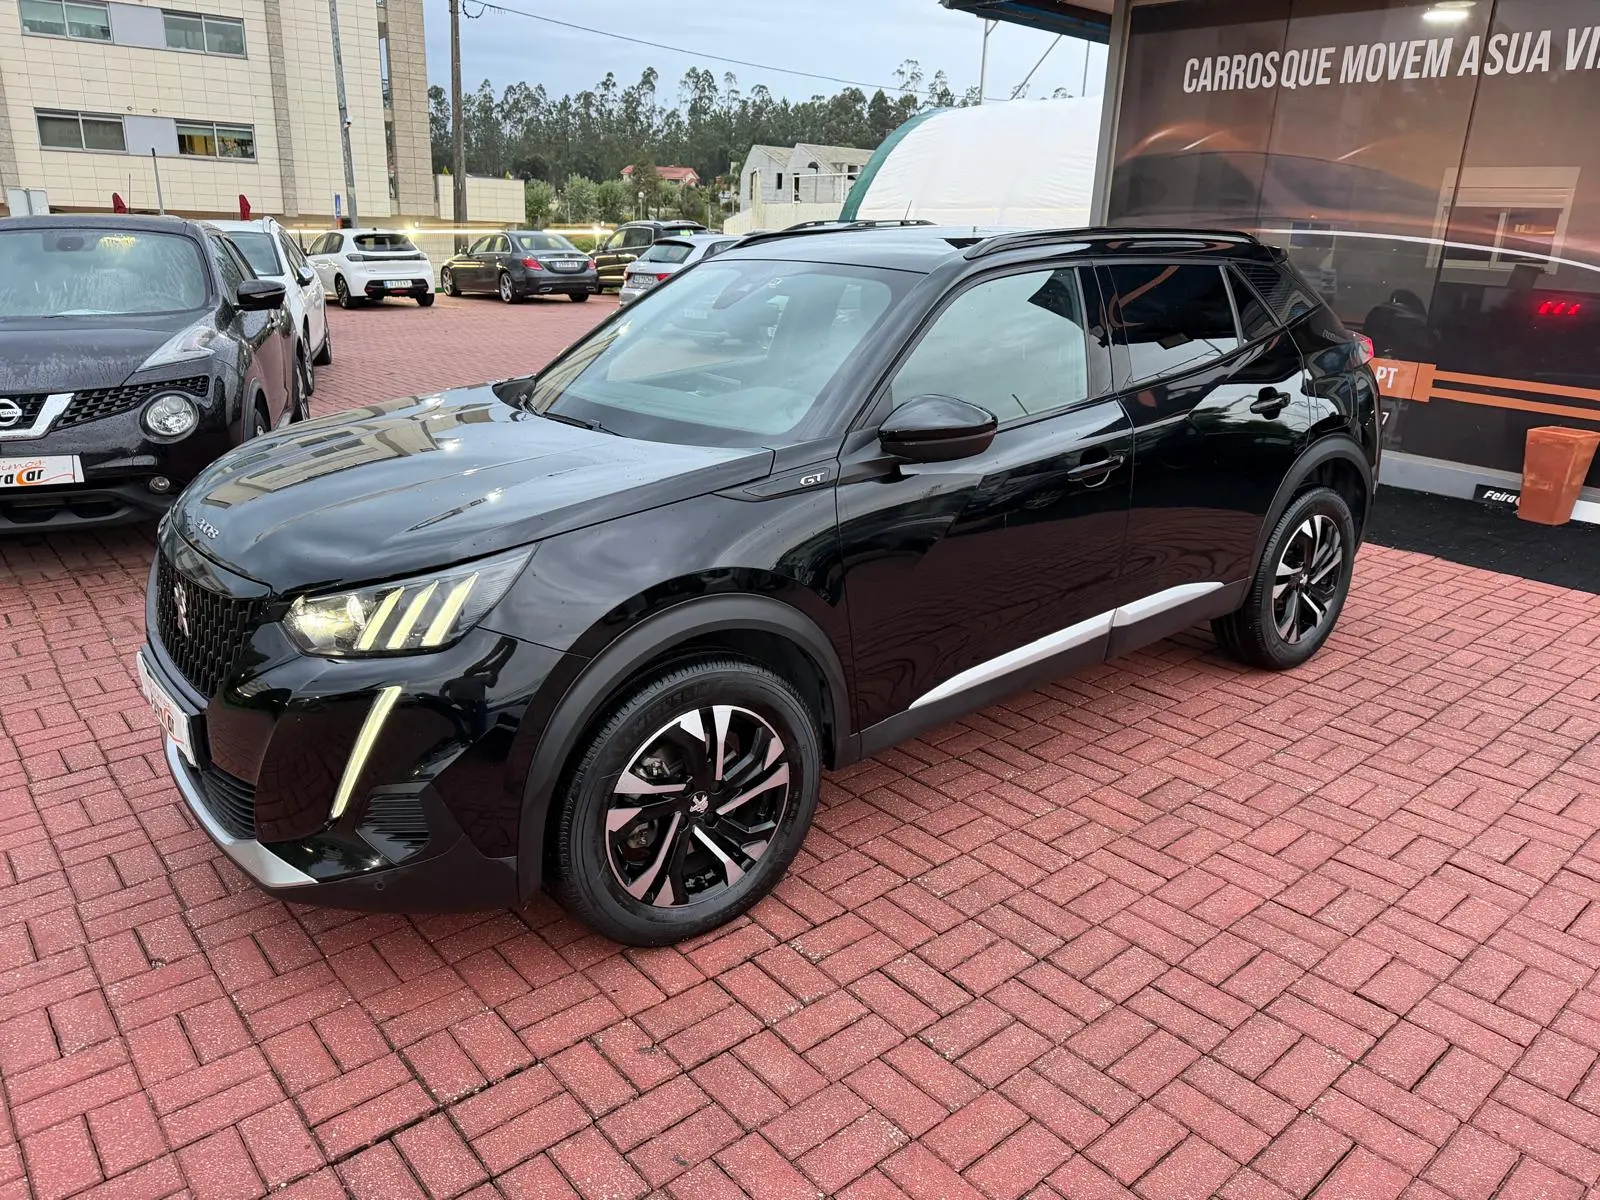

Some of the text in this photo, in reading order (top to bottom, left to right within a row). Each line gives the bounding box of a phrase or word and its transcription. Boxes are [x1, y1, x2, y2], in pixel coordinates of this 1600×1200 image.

[1183, 25, 1600, 93] CARROS QUE MOVEM A SUA VI
[800, 473, 825, 486] GT
